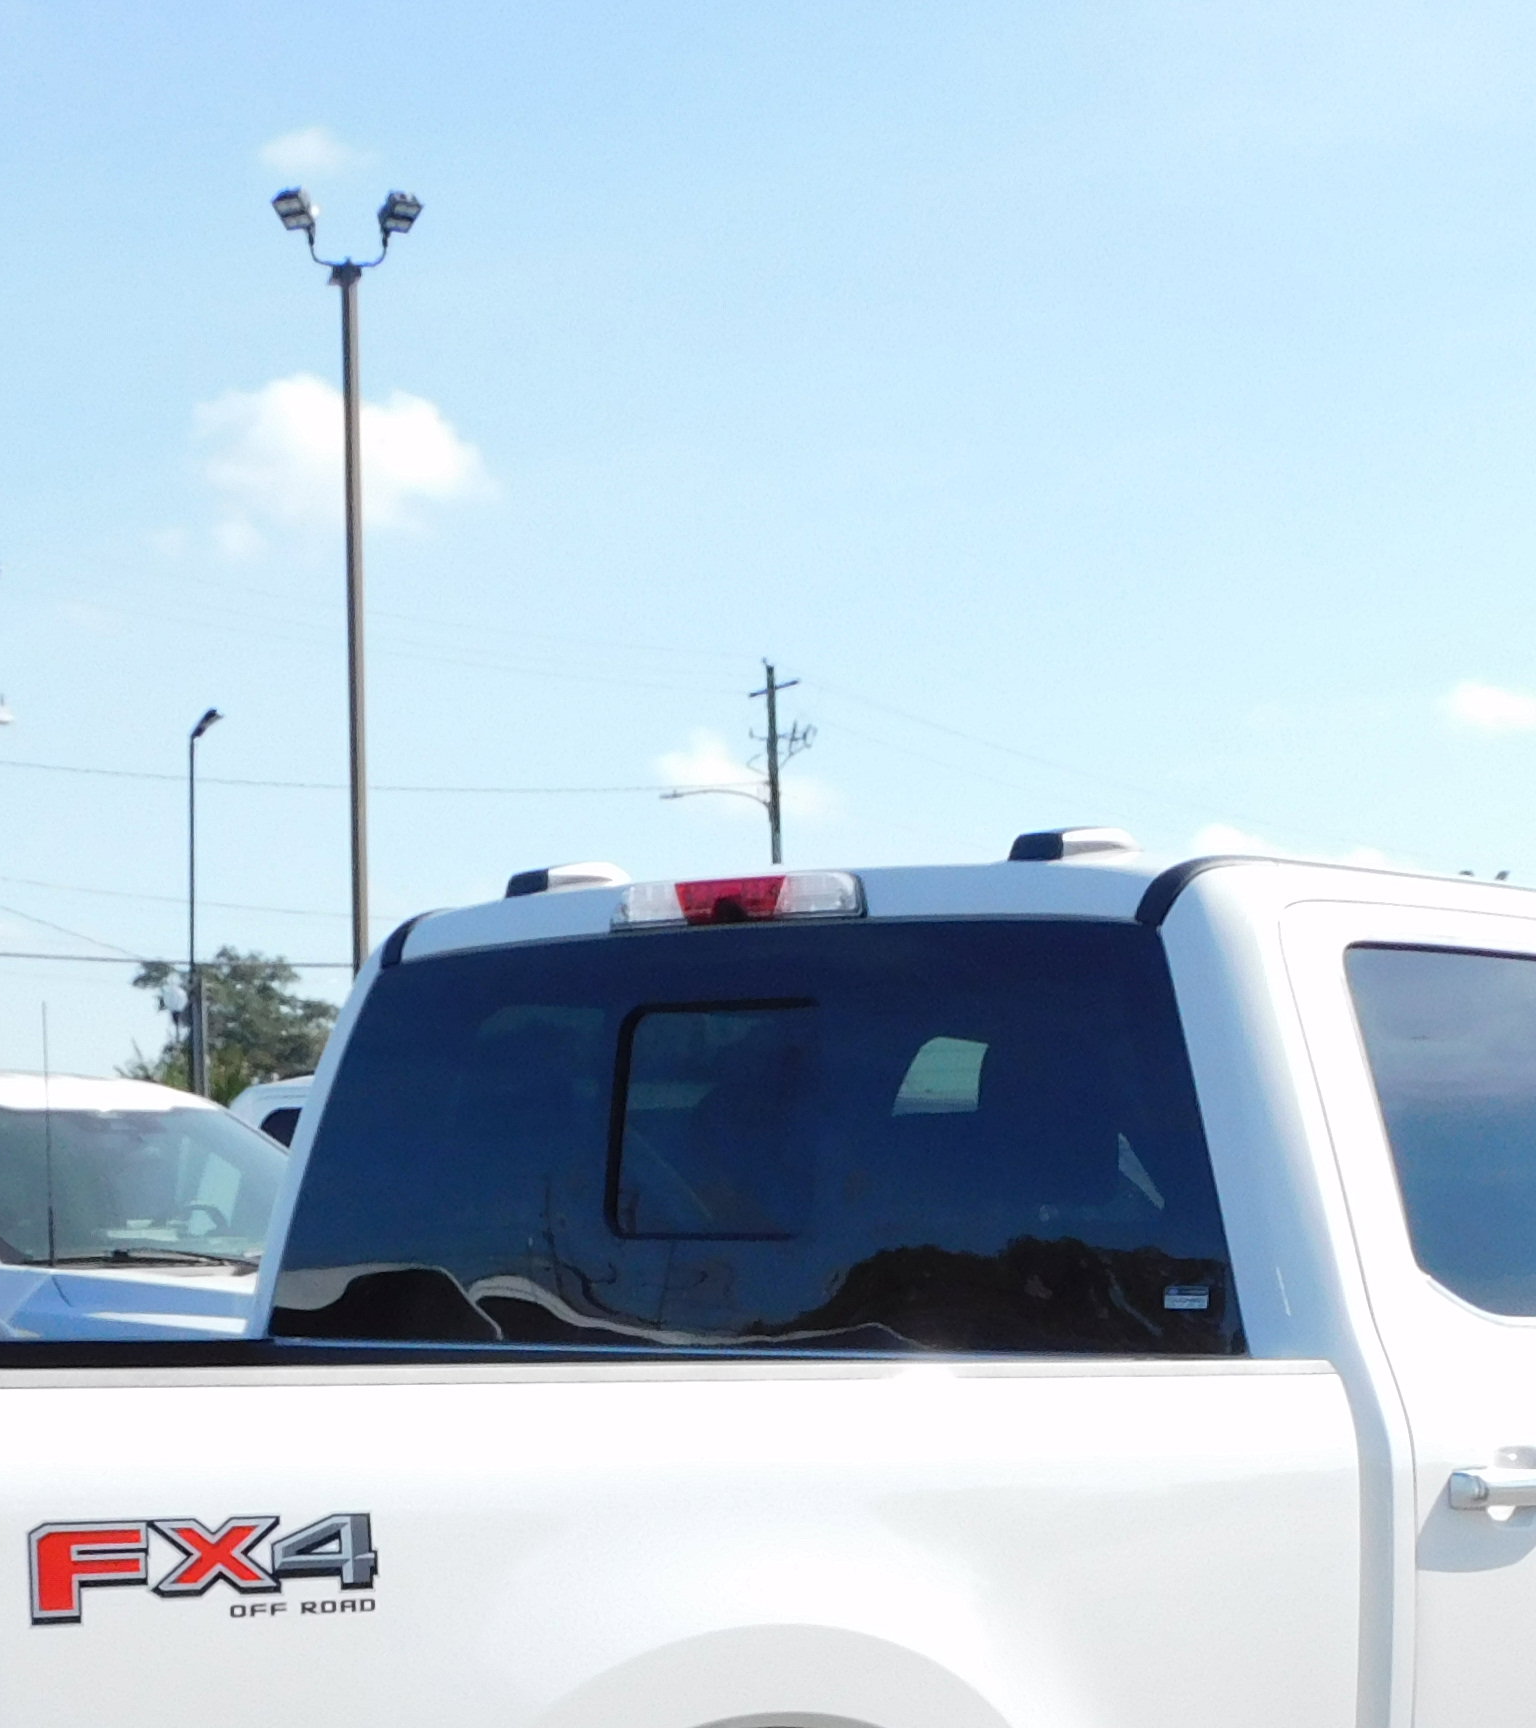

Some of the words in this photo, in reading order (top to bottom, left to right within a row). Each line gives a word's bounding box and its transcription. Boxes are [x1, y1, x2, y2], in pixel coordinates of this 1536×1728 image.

[28, 1512, 379, 1626] FX4
[229, 1600, 288, 1619] OFF
[300, 1598, 377, 1615] ROAD
